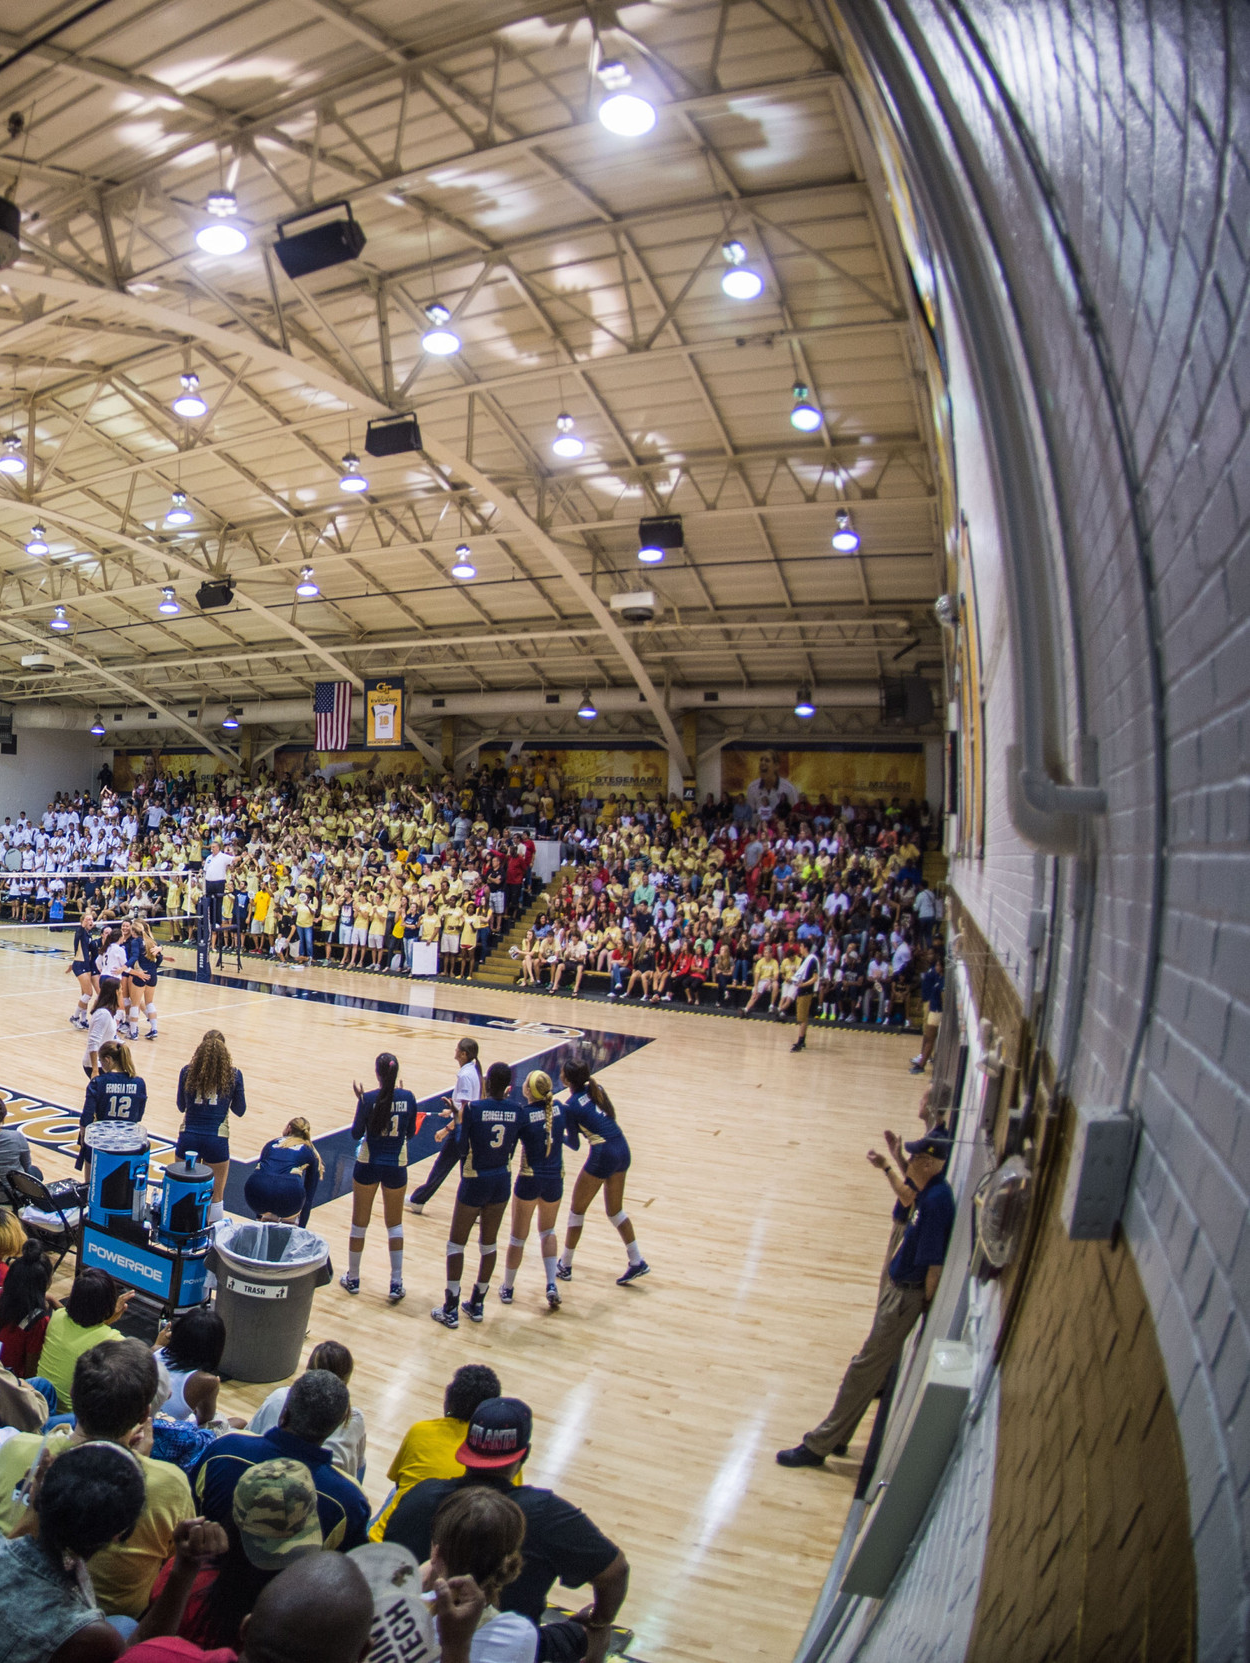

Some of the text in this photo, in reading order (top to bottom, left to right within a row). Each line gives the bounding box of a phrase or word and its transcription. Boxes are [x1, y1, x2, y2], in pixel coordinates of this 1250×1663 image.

[376, 682, 392, 694] GT
[105, 1083, 137, 1094] GEORGIA TECH
[108, 1095, 132, 1118] 12
[395, 1101, 408, 1112] TECH
[481, 1110, 516, 1122] GEORGIA TECH
[490, 1124, 506, 1148] 3
[88, 1242, 164, 1283] POWERADE
[244, 1285, 266, 1295] TRASH
